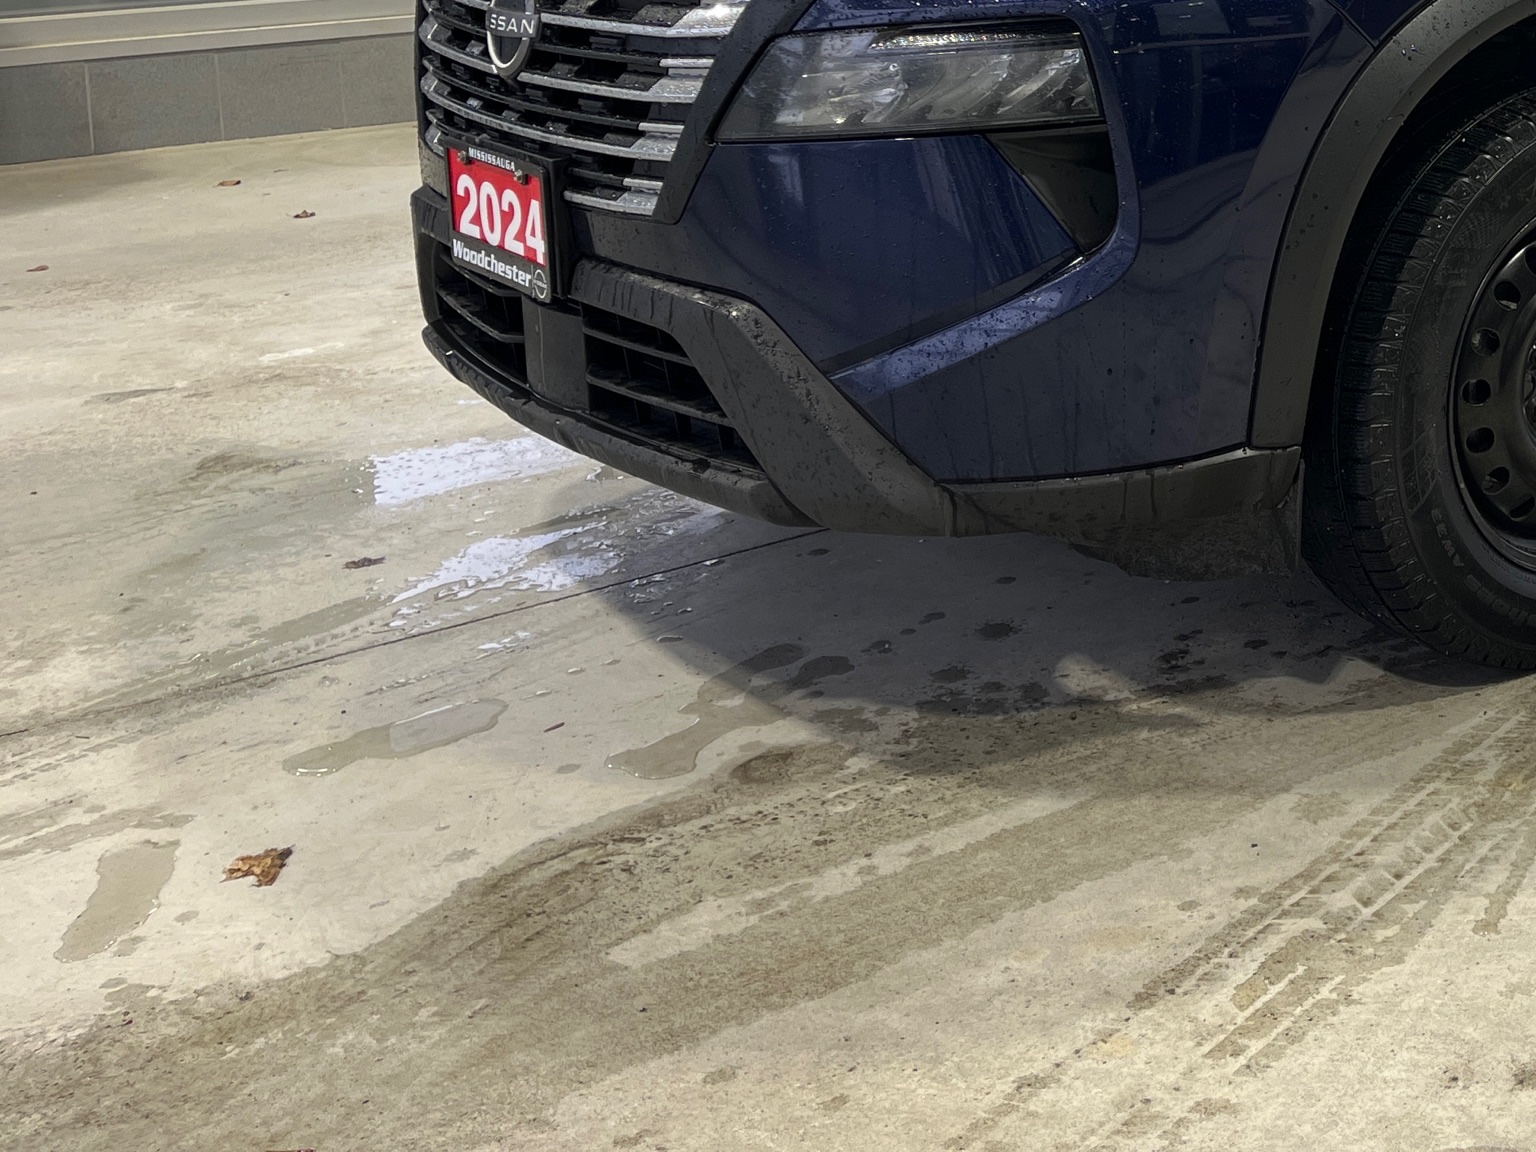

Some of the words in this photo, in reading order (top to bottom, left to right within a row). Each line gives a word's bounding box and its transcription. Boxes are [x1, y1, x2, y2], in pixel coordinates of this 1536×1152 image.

[489, 14, 535, 34] SSAN
[468, 147, 516, 171] MISSISSAUGA
[456, 174, 546, 266] 2024
[452, 238, 531, 287] Woodchester
